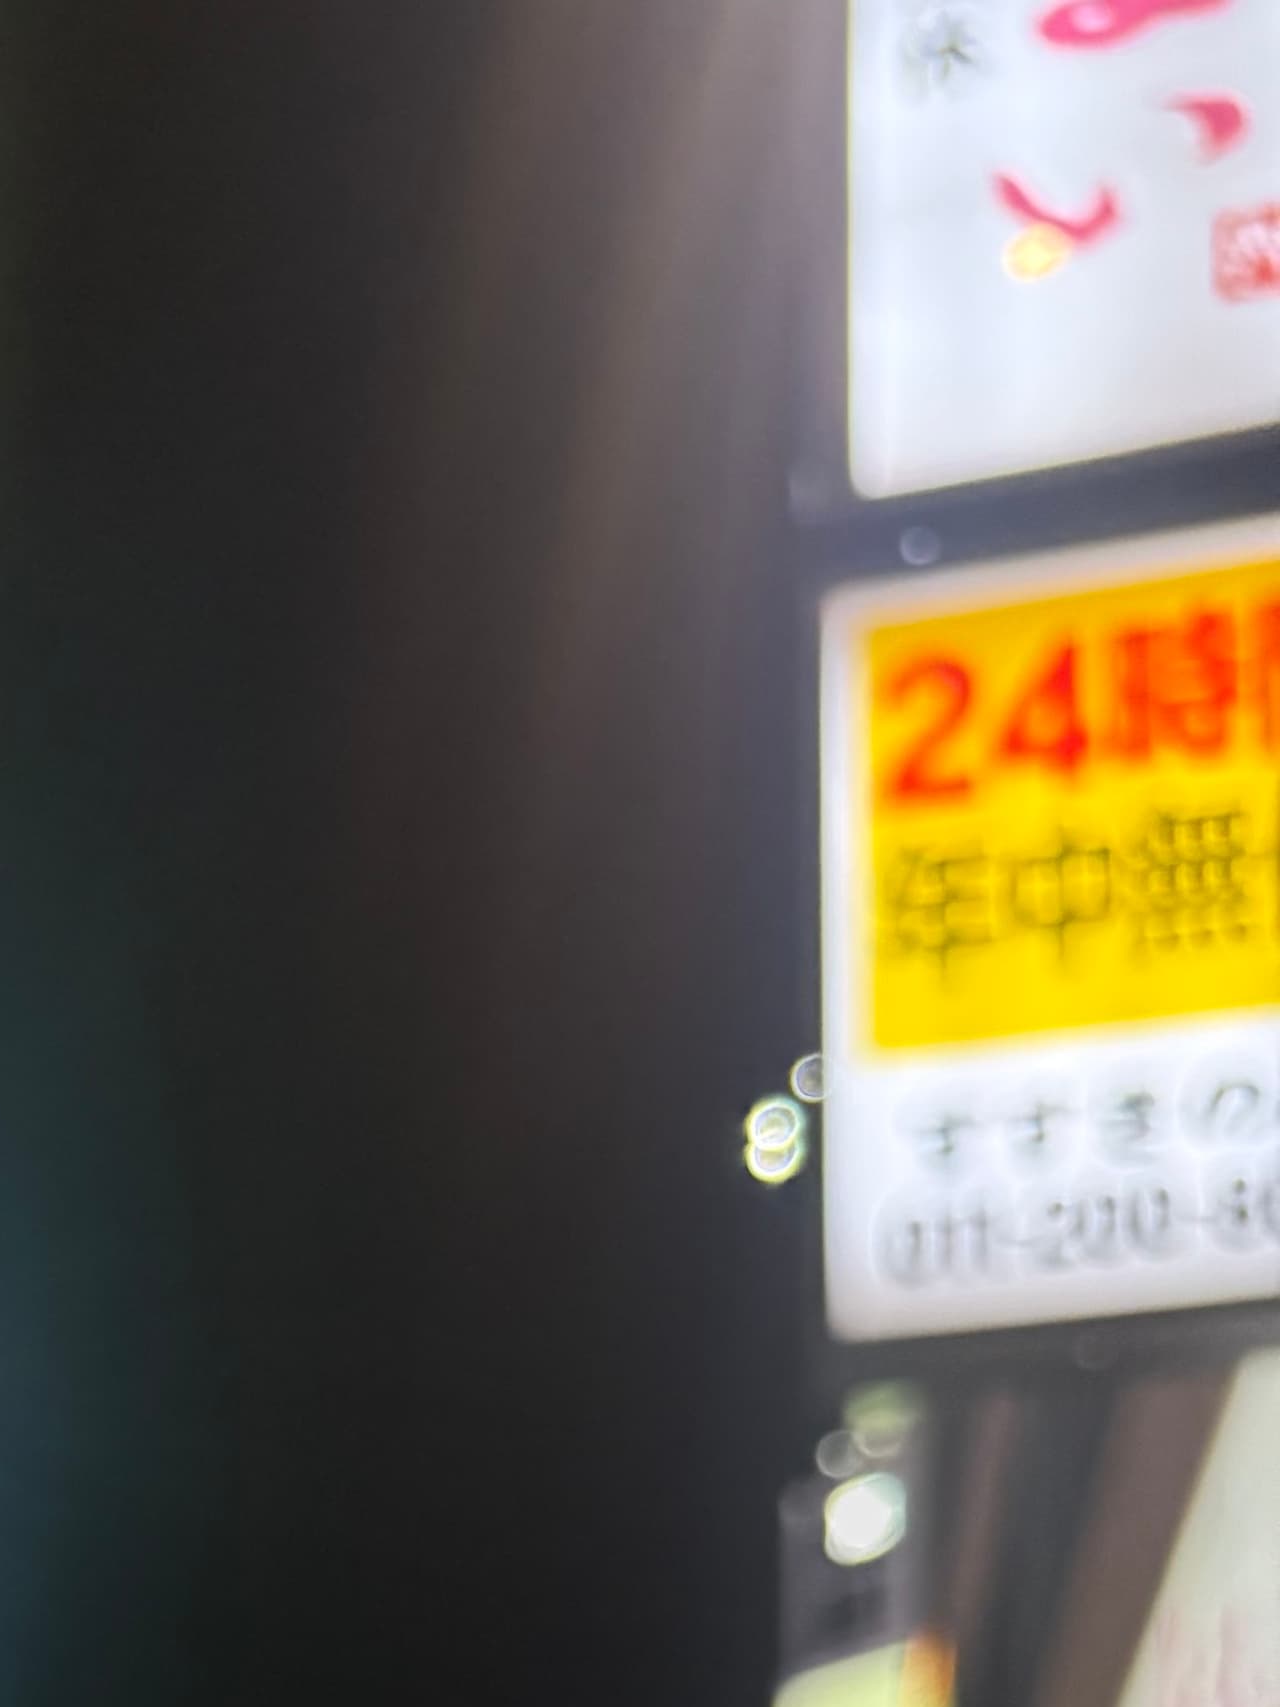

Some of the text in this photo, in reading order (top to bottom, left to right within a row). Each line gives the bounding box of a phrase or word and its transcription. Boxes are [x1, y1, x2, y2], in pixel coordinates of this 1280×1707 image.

[880, 602, 1280, 804] 24時
[887, 808, 1280, 980] 年中無
